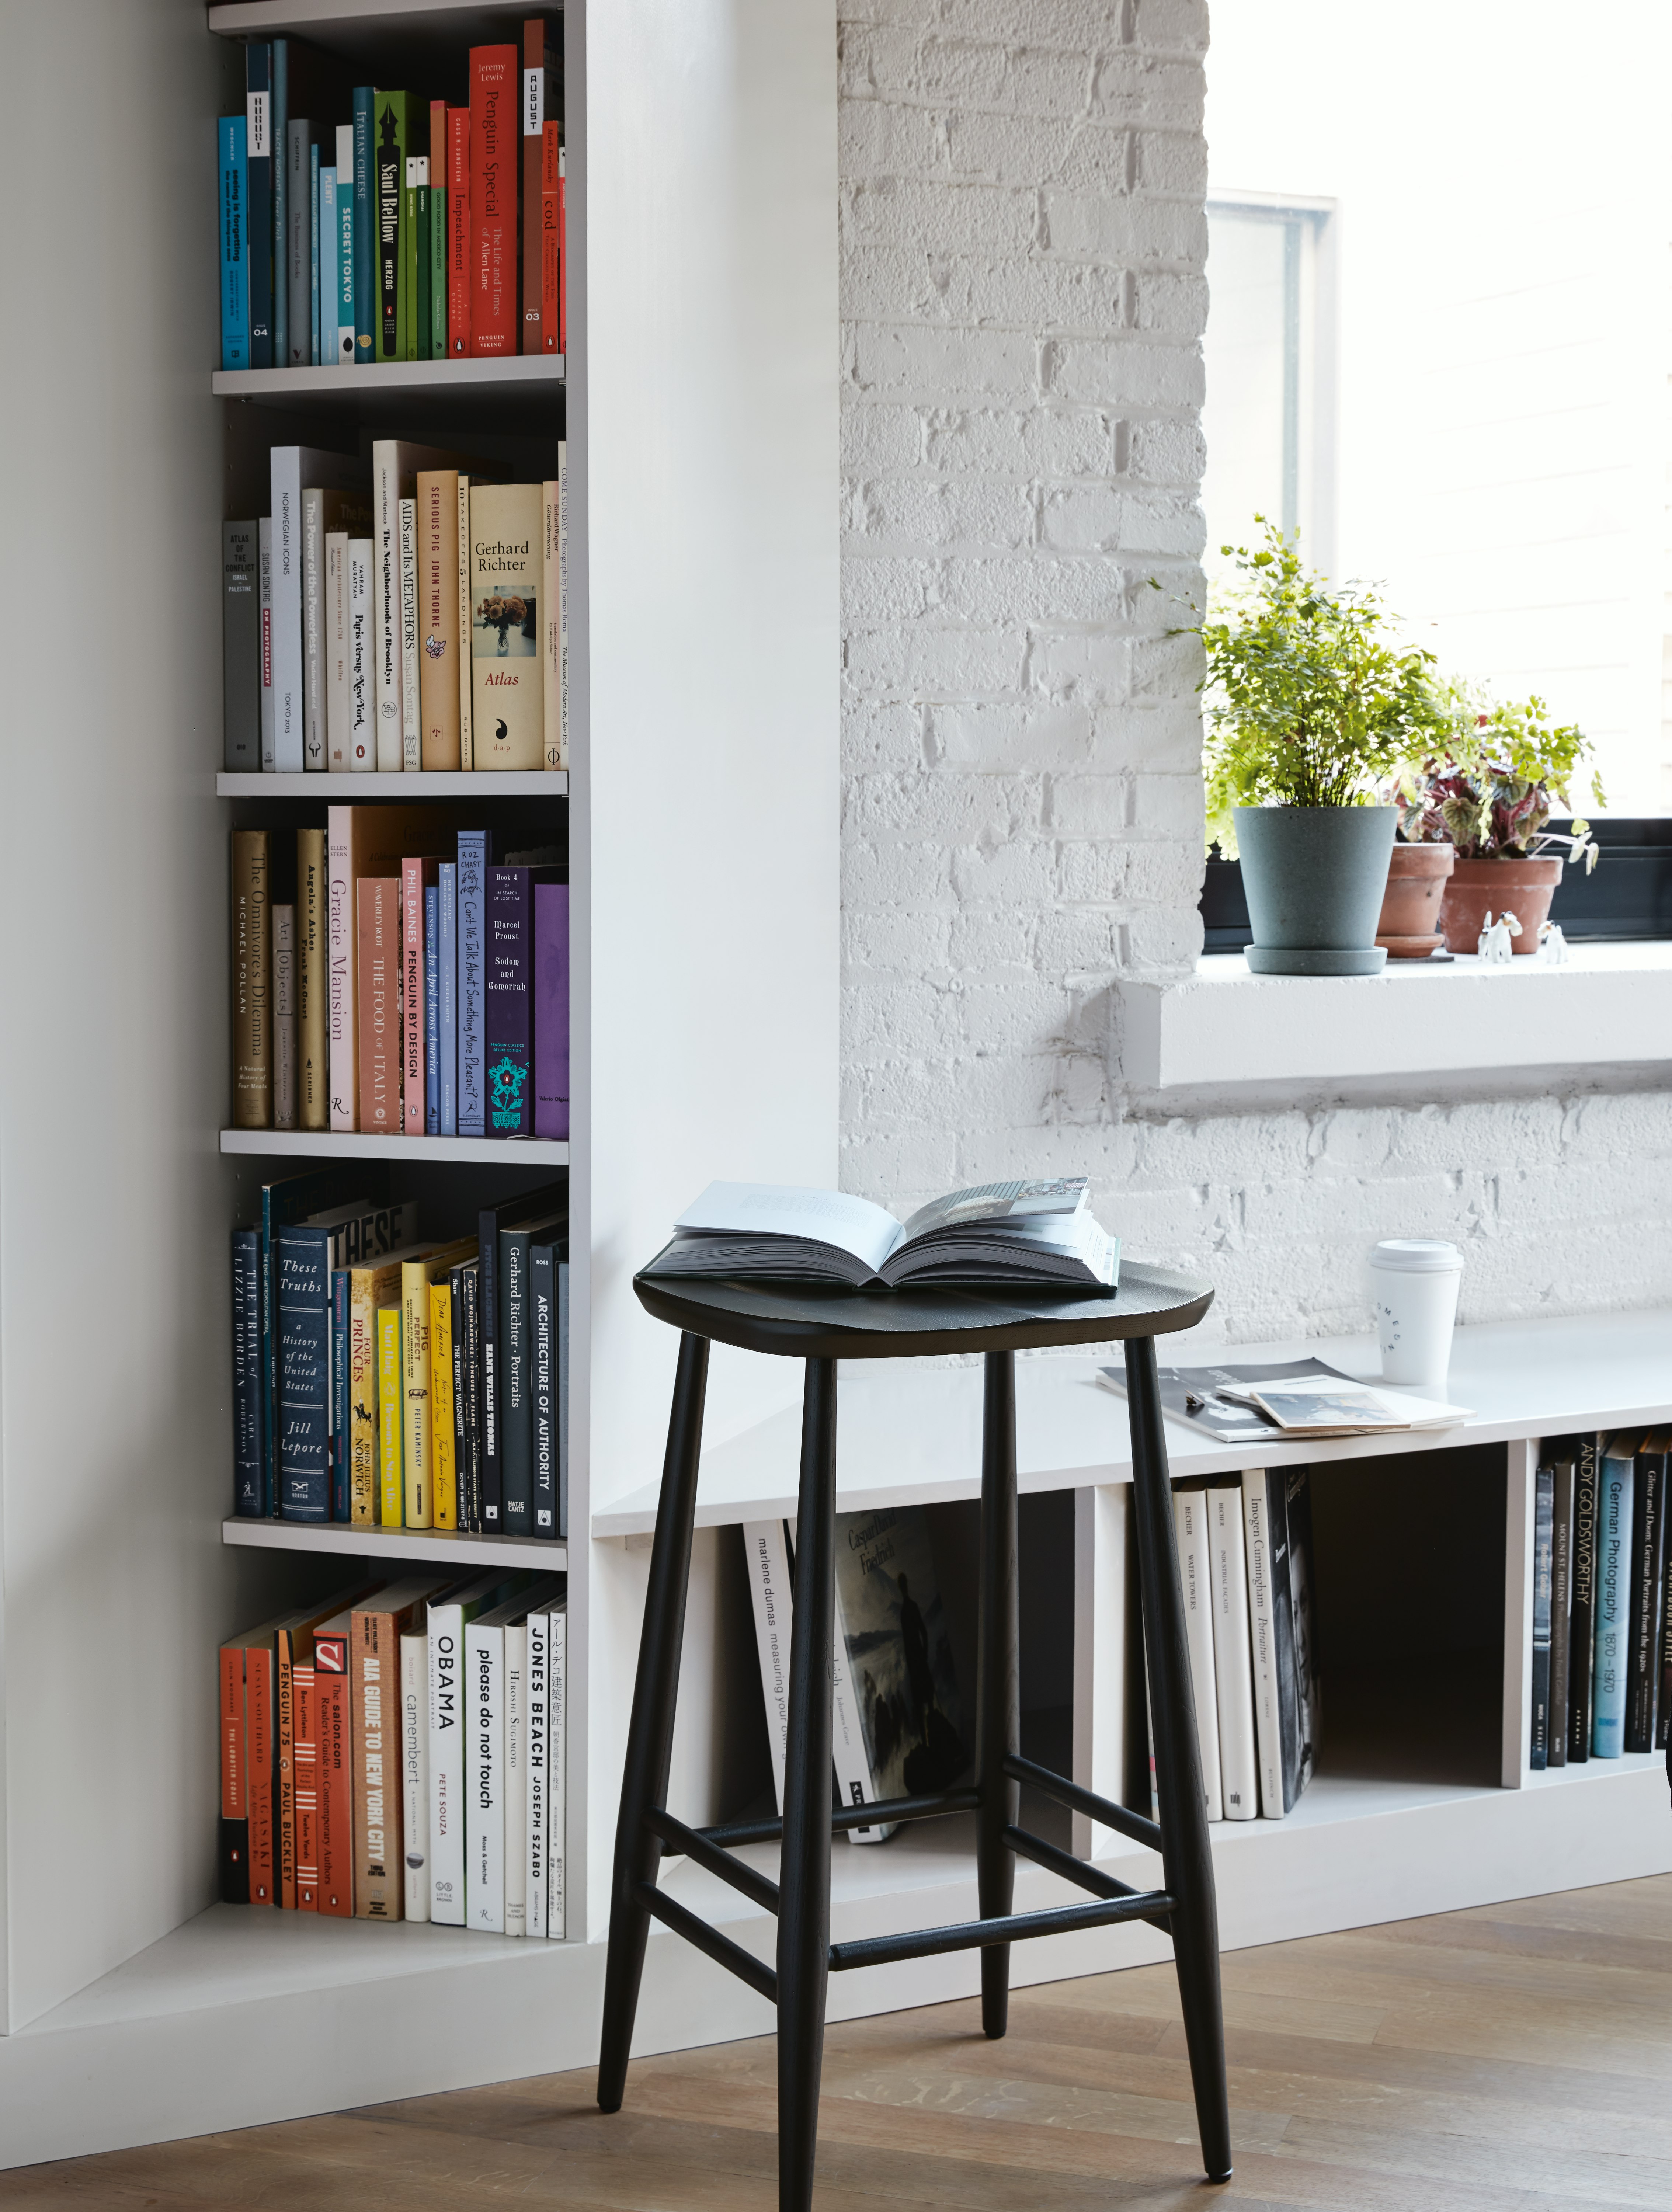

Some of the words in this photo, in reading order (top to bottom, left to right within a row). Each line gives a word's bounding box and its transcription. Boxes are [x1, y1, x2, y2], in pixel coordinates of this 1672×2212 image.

[482, 74, 503, 82] Lewis
[483, 91, 499, 154] Penguin
[231, 169, 240, 201] seeing
[324, 175, 333, 204] PLENTY
[382, 164, 397, 195] Saul
[486, 163, 499, 217] Special
[233, 203, 240, 211] is
[382, 198, 397, 243] Bellow
[544, 201, 556, 230] cod
[232, 214, 241, 261] forgetting
[343, 207, 351, 257] SECRET
[454, 194, 465, 271] Impeachment
[482, 227, 490, 237] of
[482, 241, 490, 265] Allen
[493, 227, 502, 244] The
[385, 260, 393, 290] HERZOG
[493, 248, 502, 265] Life
[493, 268, 502, 284] and
[343, 260, 352, 302] TOKYO
[482, 269, 490, 290] Lane
[493, 287, 502, 316] Times
[282, 493, 290, 545] NORWEGIAN
[401, 501, 413, 533] AIDS
[431, 487, 440, 529] SERIOUS
[282, 548, 291, 575] ICONS
[403, 535, 413, 553] and
[403, 555, 413, 569] Its
[431, 535, 439, 551] PIG
[476, 542, 529, 555] Gerhard
[431, 560, 439, 585] JOHN
[479, 559, 525, 571] Richter
[382, 551, 392, 624] Neighborhoods
[432, 589, 440, 627] THORNE
[264, 611, 269, 622] ON
[404, 571, 415, 649] METAPHORS
[385, 627, 392, 637] of
[383, 638, 393, 684] Brooklyn
[484, 672, 519, 685] Atlas
[404, 686, 416, 724] Sontag
[251, 854, 265, 884] The
[307, 865, 316, 914] Angela's
[407, 870, 416, 898] PHIL
[251, 890, 266, 978] Omnivore's
[331, 880, 347, 946] Gracie
[407, 900, 417, 942] BAINES
[494, 921, 520, 929] Marcel
[373, 957, 385, 986] THE
[408, 950, 417, 1008] PENGUIN
[495, 957, 519, 966] Sodom
[332, 955, 347, 1041] Mansion
[489, 981, 526, 991] Gomorrah
[251, 985, 267, 1056] Dilemma
[373, 991, 385, 1033] FOOD
[409, 1013, 417, 1027] BY
[375, 1038, 383, 1050] OF
[409, 1033, 419, 1078] DESIGN
[374, 1055, 385, 1103] ITALY
[509, 1247, 522, 1298] Gerhard
[335, 1277, 344, 1322] Wittgenstein
[510, 1302, 522, 1346] Richter
[538, 1295, 549, 1391] ARCHITECTURE
[335, 1333, 344, 1380] Philosophical
[353, 1319, 364, 1382] PRINCES
[486, 1344, 494, 1372] HANK
[510, 1356, 522, 1408] Portraits
[335, 1382, 344, 1430] Investigations
[455, 1394, 463, 1436] WAGNERITE
[539, 1396, 549, 1413] OF
[487, 1413, 495, 1455] THOMAS
[539, 1417, 550, 1490] AUTHORITY
[355, 1438, 365, 1496] NORWICH
[1581, 1443, 1593, 1485] ANDY
[1184, 1506, 1193, 1535] BECHER
[1250, 1498, 1262, 1537] Imogen
[1608, 1481, 1621, 1535] German
[758, 1538, 771, 1585] marlene
[1577, 1488, 1592, 1604] GOLDSWORTHY
[1253, 1540, 1265, 1608] Cunningham
[1605, 1539, 1620, 1623] Photography
[764, 1589, 776, 1627] dumas
[532, 1628, 543, 1693] JONES
[1257, 1617, 1267, 1665] Portraiture
[1605, 1632, 1616, 1657] 1870
[363, 1658, 379, 1681] AIA
[438, 1635, 455, 1730] OBAMA
[477, 1650, 493, 1703] please
[770, 1633, 784, 1693] measuring
[1603, 1669, 1616, 1693] 1970
[281, 1663, 289, 1725] PENGUIN
[364, 1686, 381, 1728] GUIDE
[333, 1704, 342, 1769] salon.com
[479, 1707, 492, 1728] do
[531, 1703, 544, 1767] BEACH
[281, 1732, 290, 1746] 75
[365, 1732, 382, 1749] TO
[406, 1695, 420, 1784] camembert
[480, 1733, 492, 1760] not
[365, 1753, 383, 1785] NEW
[480, 1765, 493, 1809] touch
[282, 1782, 291, 1815] PAUL
[366, 1790, 383, 1825] YORK
[532, 1777, 541, 1827] JOSEPH
[282, 1821, 292, 1883] BUCKLEY
[368, 1829, 385, 1861] CITY
[532, 1834, 541, 1878] SZABO
